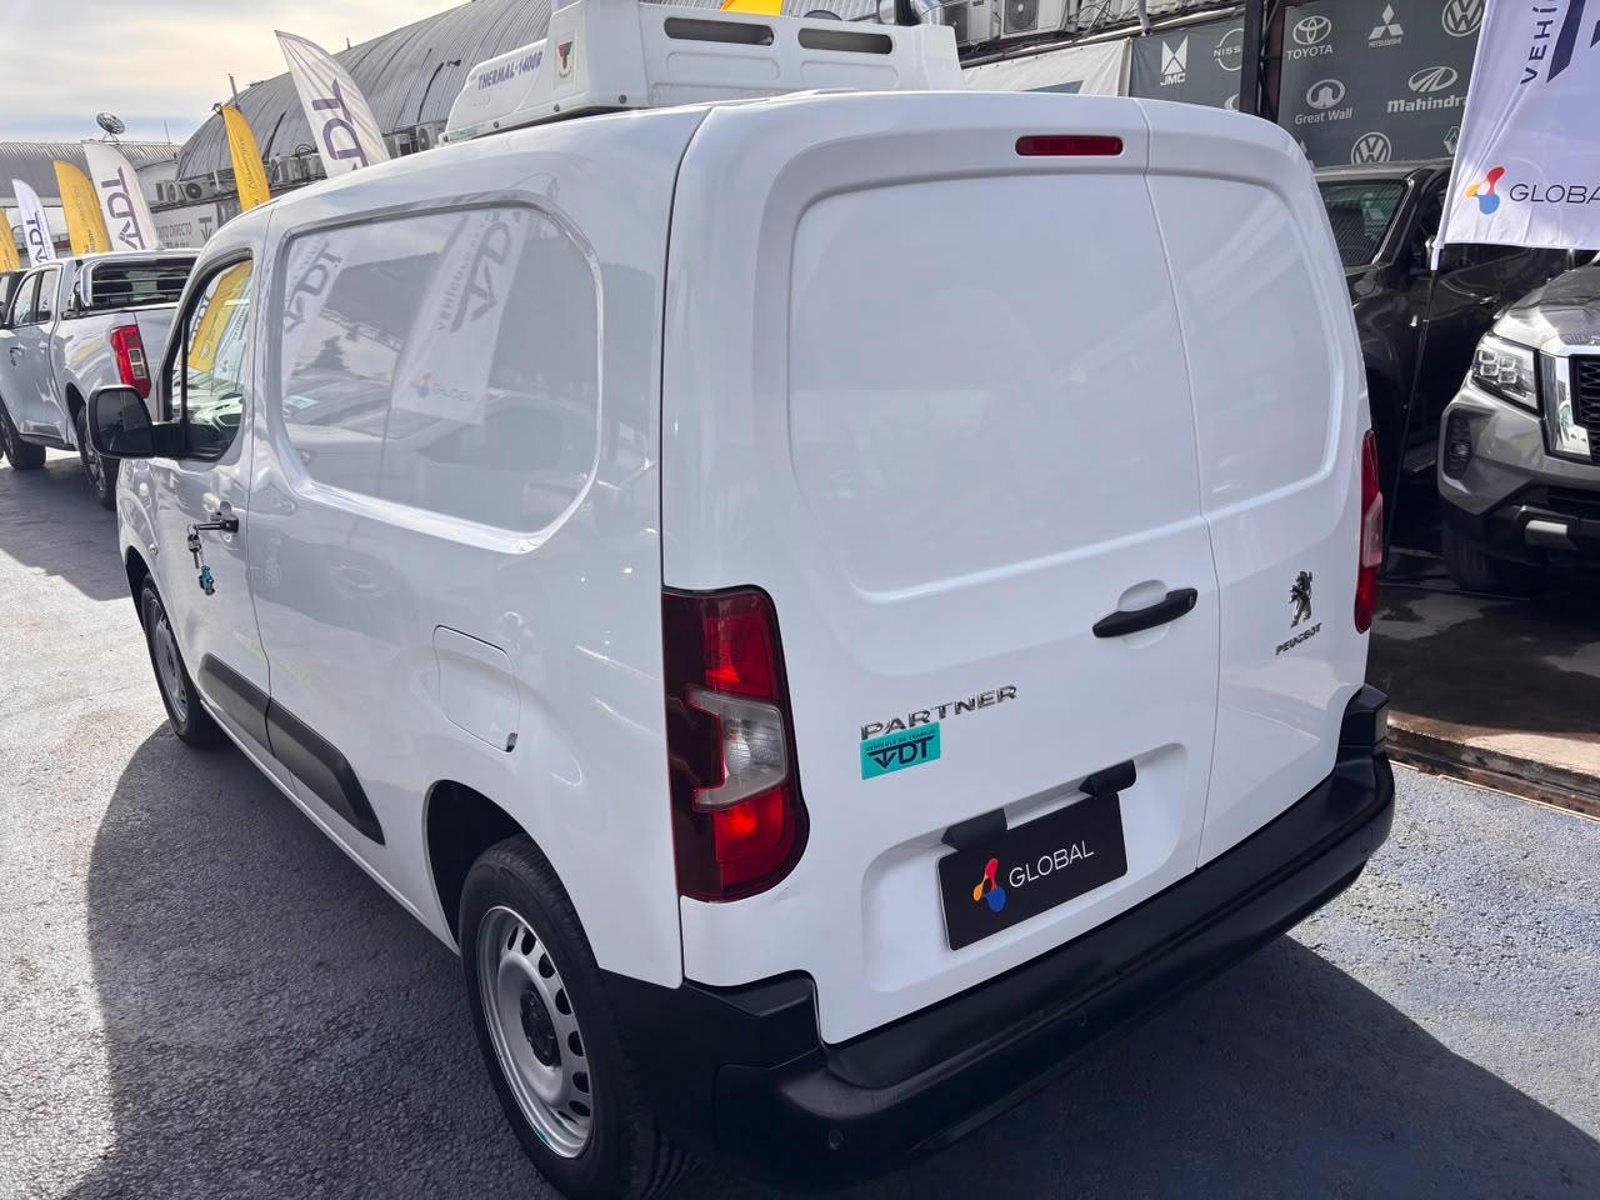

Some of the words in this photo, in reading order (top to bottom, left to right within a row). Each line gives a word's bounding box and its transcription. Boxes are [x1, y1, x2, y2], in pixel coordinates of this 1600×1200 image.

[1213, 45, 1242, 57] NISS
[1287, 44, 1333, 61] TOYOTA
[1160, 73, 1186, 86] JMC
[1294, 112, 1325, 126] Great
[1328, 107, 1353, 121] Wall
[1275, 622, 1323, 656] PEUGEOT
[860, 683, 1017, 741] PARTNER
[1008, 839, 1096, 888] GLOBAL
